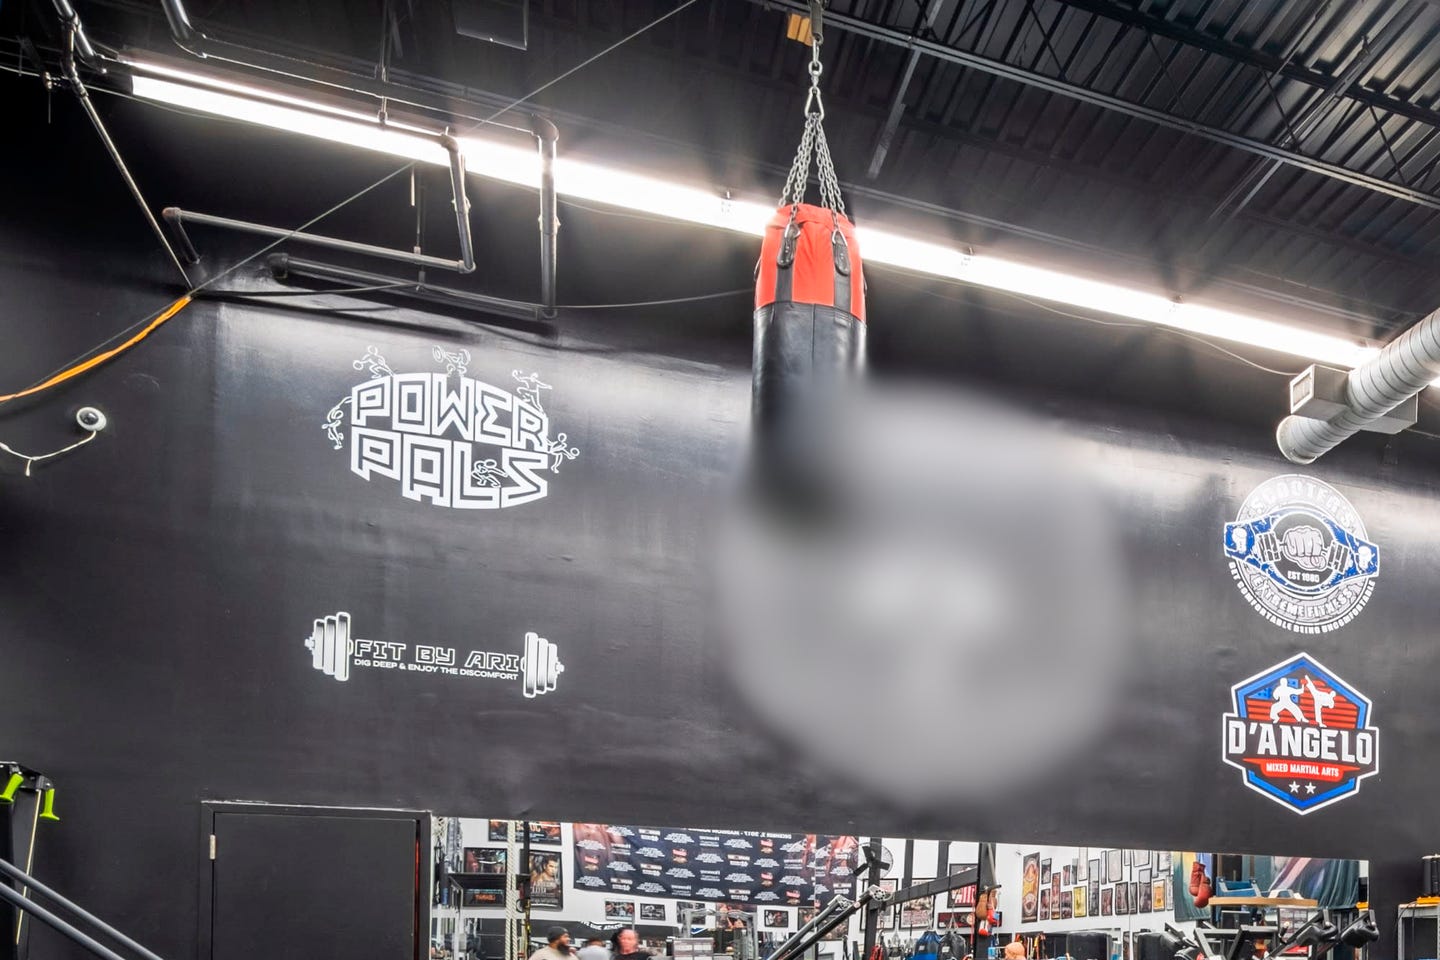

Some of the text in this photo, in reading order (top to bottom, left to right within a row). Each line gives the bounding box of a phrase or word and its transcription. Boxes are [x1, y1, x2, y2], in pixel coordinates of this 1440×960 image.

[351, 372, 549, 454] POWER
[350, 425, 549, 510] PALS
[1287, 570, 1301, 580] EST
[1253, 575, 1353, 617] EXTREME FITNESS
[354, 639, 519, 672] FIT BY ARI
[354, 658, 519, 681] DIG DEEP & ENJOY THE DISCOMFORT
[1228, 720, 1373, 765] D'ANGELO
[1266, 763, 1339, 777] MIXED MARTIAL ARTS
